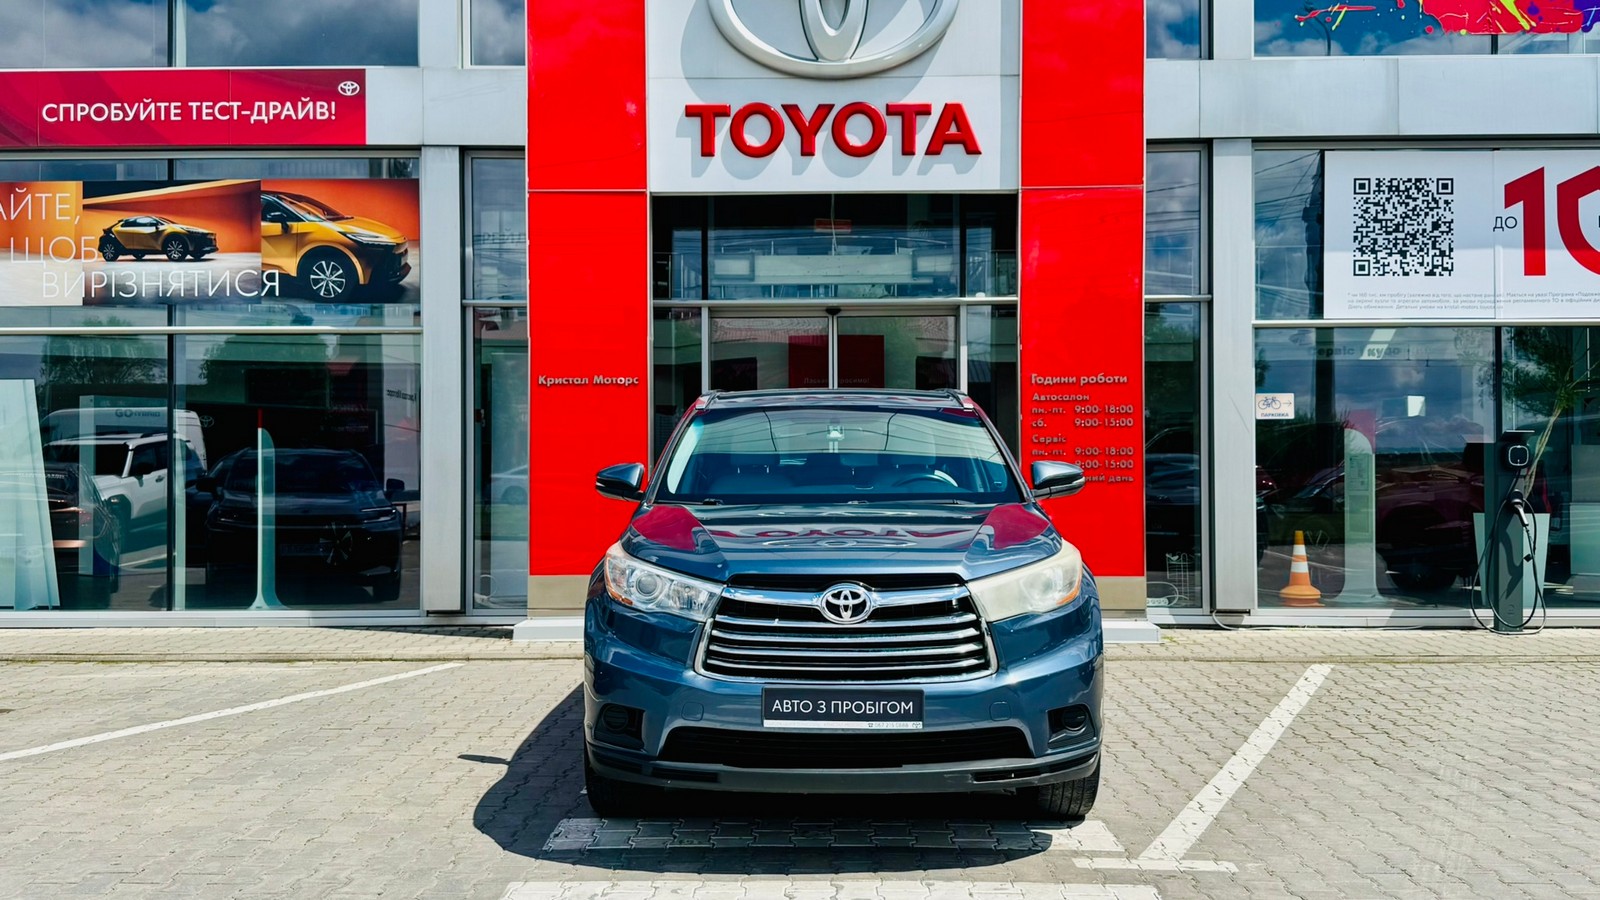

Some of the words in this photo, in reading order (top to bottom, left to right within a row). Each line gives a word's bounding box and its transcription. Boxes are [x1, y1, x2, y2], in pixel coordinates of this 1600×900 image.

[42, 98, 182, 122] СПРОБУЙТЕ
[188, 97, 337, 124] ТЕСТ-ДРАЙВ!
[685, 102, 982, 158] TOYOTA
[0, 187, 81, 225] ЙТЕ,
[1493, 216, 1518, 232] ДО
[10, 236, 98, 267] ЩОБ
[43, 269, 280, 298] ВИРІЗНЯТИСЯ
[538, 374, 588, 387] Кристал
[593, 374, 639, 387] Моторс
[1031, 373, 1077, 385] Години
[1080, 372, 1128, 385] роботи
[1032, 392, 1090, 401] Автосалон
[1032, 418, 1047, 427] сб.
[1032, 433, 1066, 445] Сервіс
[1108, 474, 1134, 483] день
[772, 699, 813, 713] АВТО
[831, 700, 914, 715] ПРОБІГОМ
